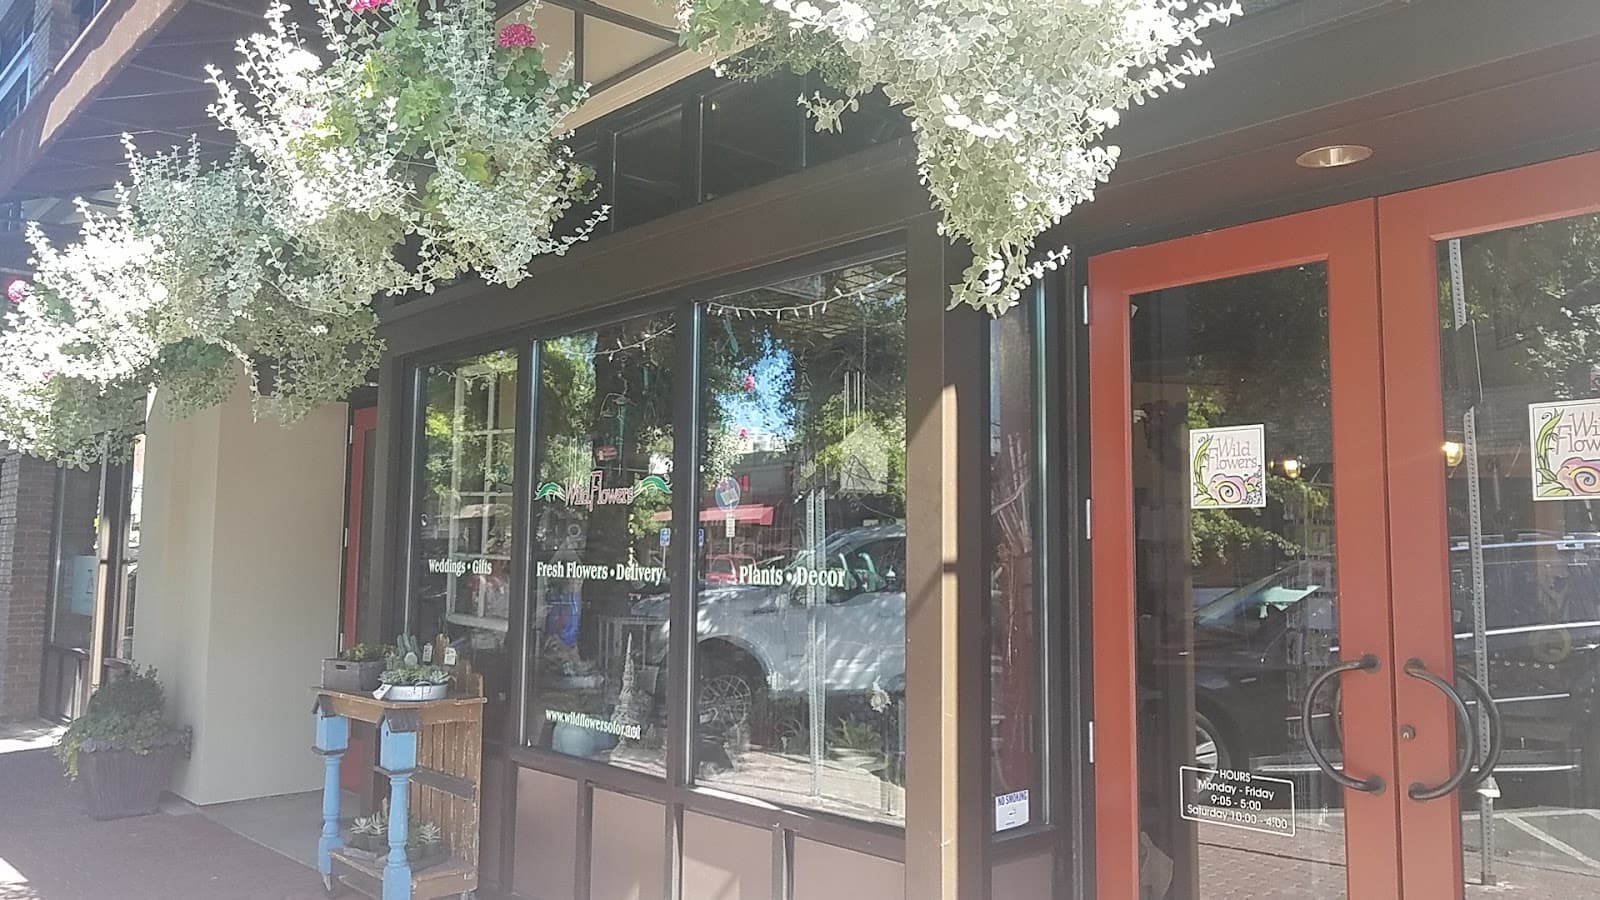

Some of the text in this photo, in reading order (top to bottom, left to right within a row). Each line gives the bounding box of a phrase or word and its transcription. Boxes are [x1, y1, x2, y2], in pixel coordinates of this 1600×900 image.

[1569, 411, 1600, 438] Wi
[1216, 437, 1251, 457] Wild
[1207, 447, 1258, 472] Flowers
[428, 558, 492, 577] Weddings Gifts
[536, 562, 663, 586] Fresh Flowers Delivery
[739, 565, 847, 588] Plants Decor
[1220, 769, 1251, 782] HOURS
[1198, 780, 1237, 795] Monday
[1245, 786, 1275, 801] Friday
[1211, 794, 1232, 807] 9:05
[1240, 799, 1261, 811] 5:00
[1187, 804, 1228, 820] Saturday
[1231, 810, 1257, 824] 10:00
[1265, 817, 1288, 830] 4:00
